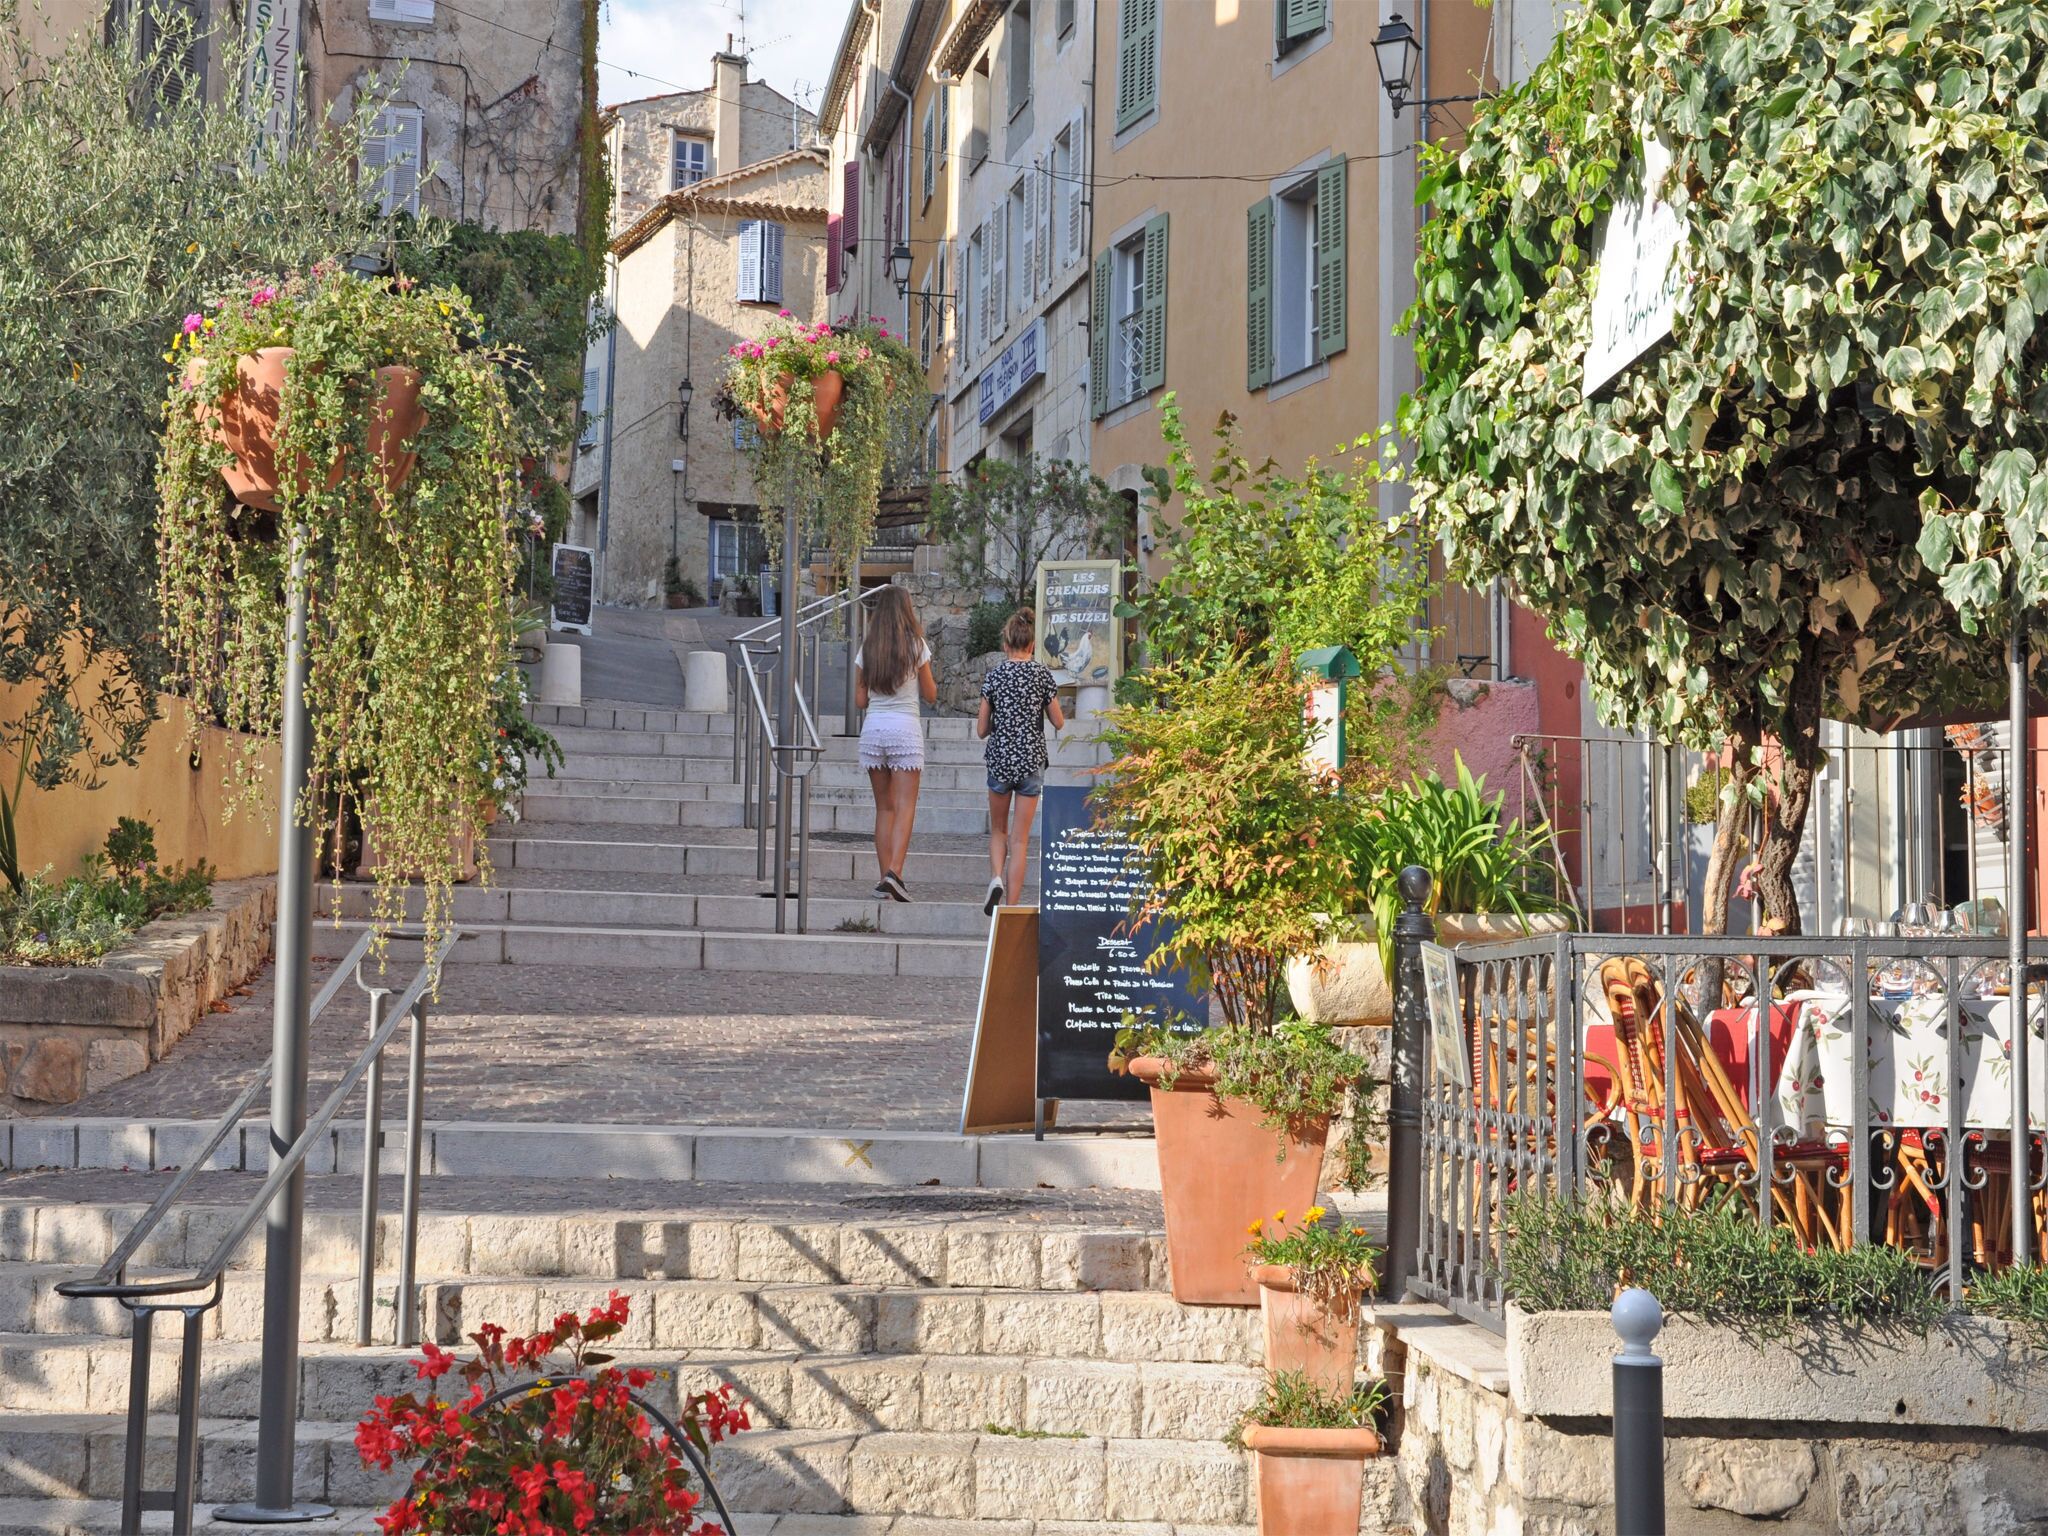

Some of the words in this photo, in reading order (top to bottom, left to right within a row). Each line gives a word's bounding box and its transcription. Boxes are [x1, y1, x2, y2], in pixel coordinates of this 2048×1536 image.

[1072, 572, 1096, 583] LES
[1045, 584, 1110, 596] GRENIERS
[1051, 613, 1068, 624] DE
[1069, 612, 1109, 623] SUZEL
